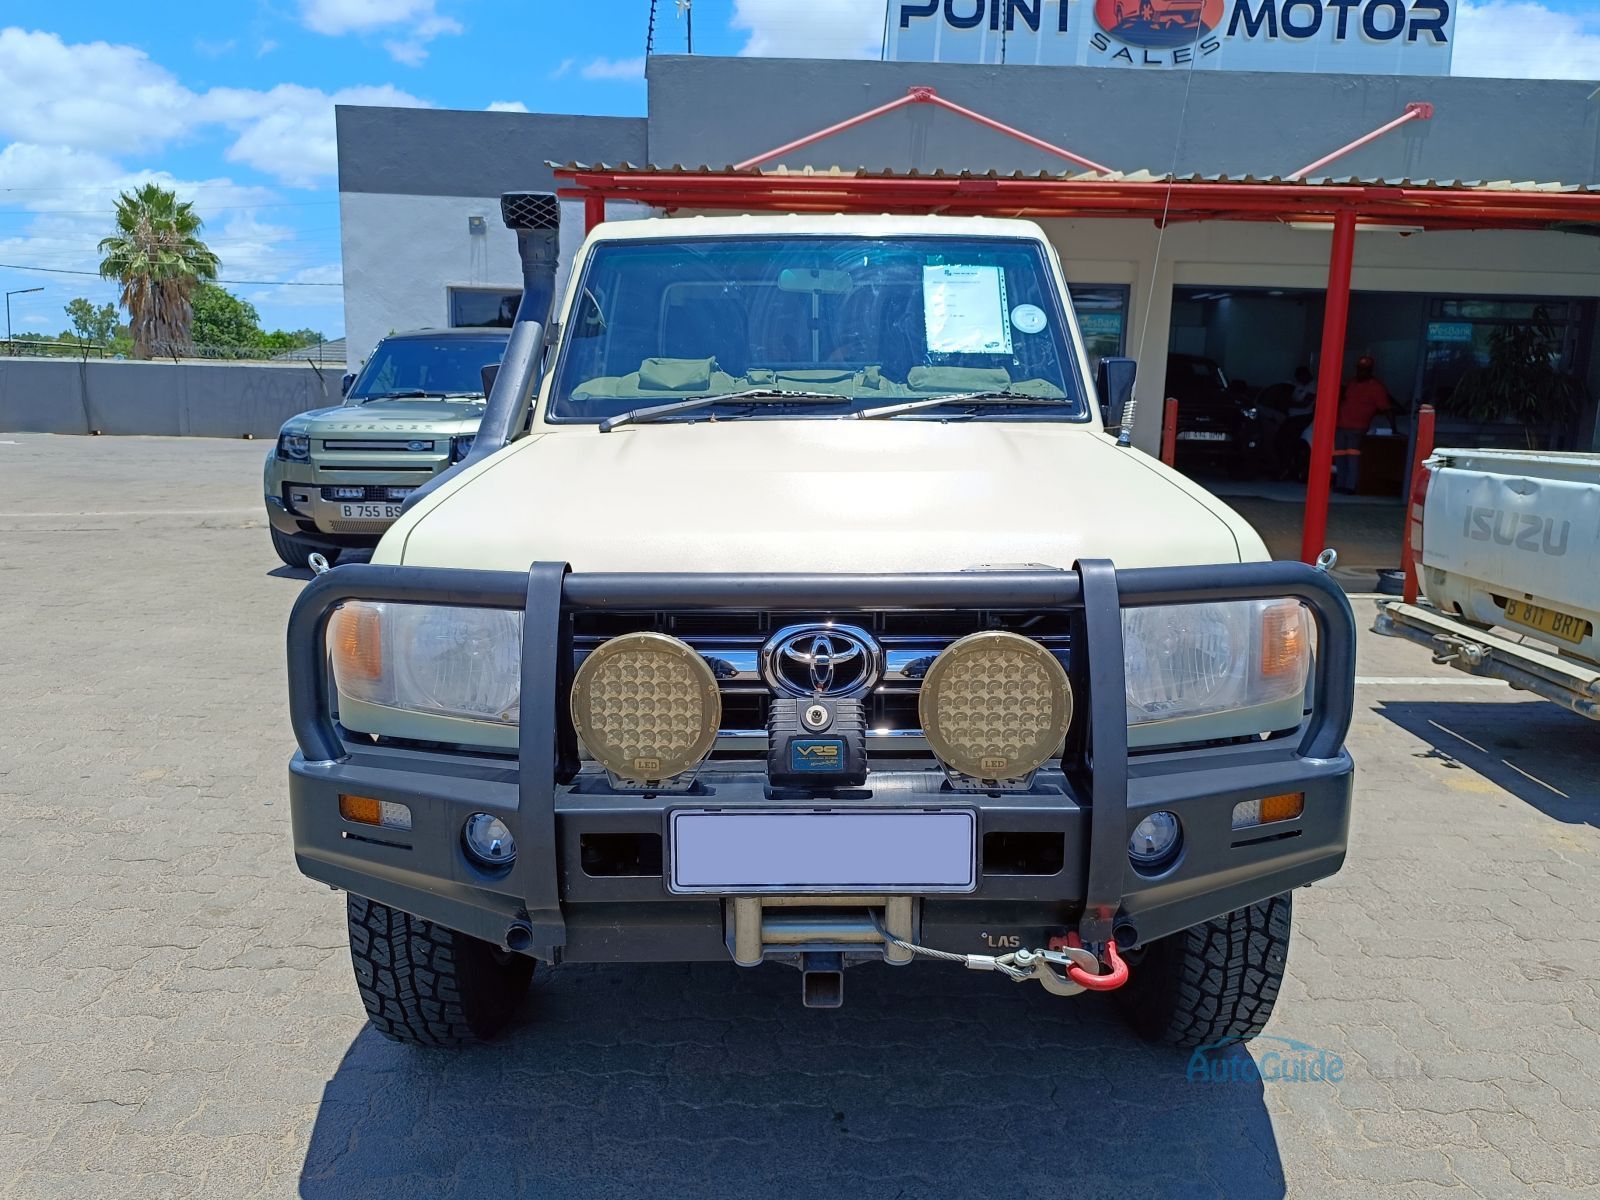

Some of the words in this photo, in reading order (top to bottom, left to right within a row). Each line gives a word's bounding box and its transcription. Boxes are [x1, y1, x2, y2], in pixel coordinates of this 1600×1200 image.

[900, 0, 1068, 32] POINT
[1227, 0, 1450, 43] MOTOR
[1090, 32, 1221, 65] SALES
[344, 505, 352, 517] B
[357, 505, 380, 517] 755
[1463, 505, 1570, 557] ISUZU
[1507, 600, 1516, 616] B
[1552, 611, 1584, 638] BRT
[638, 761, 657, 769] LED
[985, 760, 1005, 768] LED
